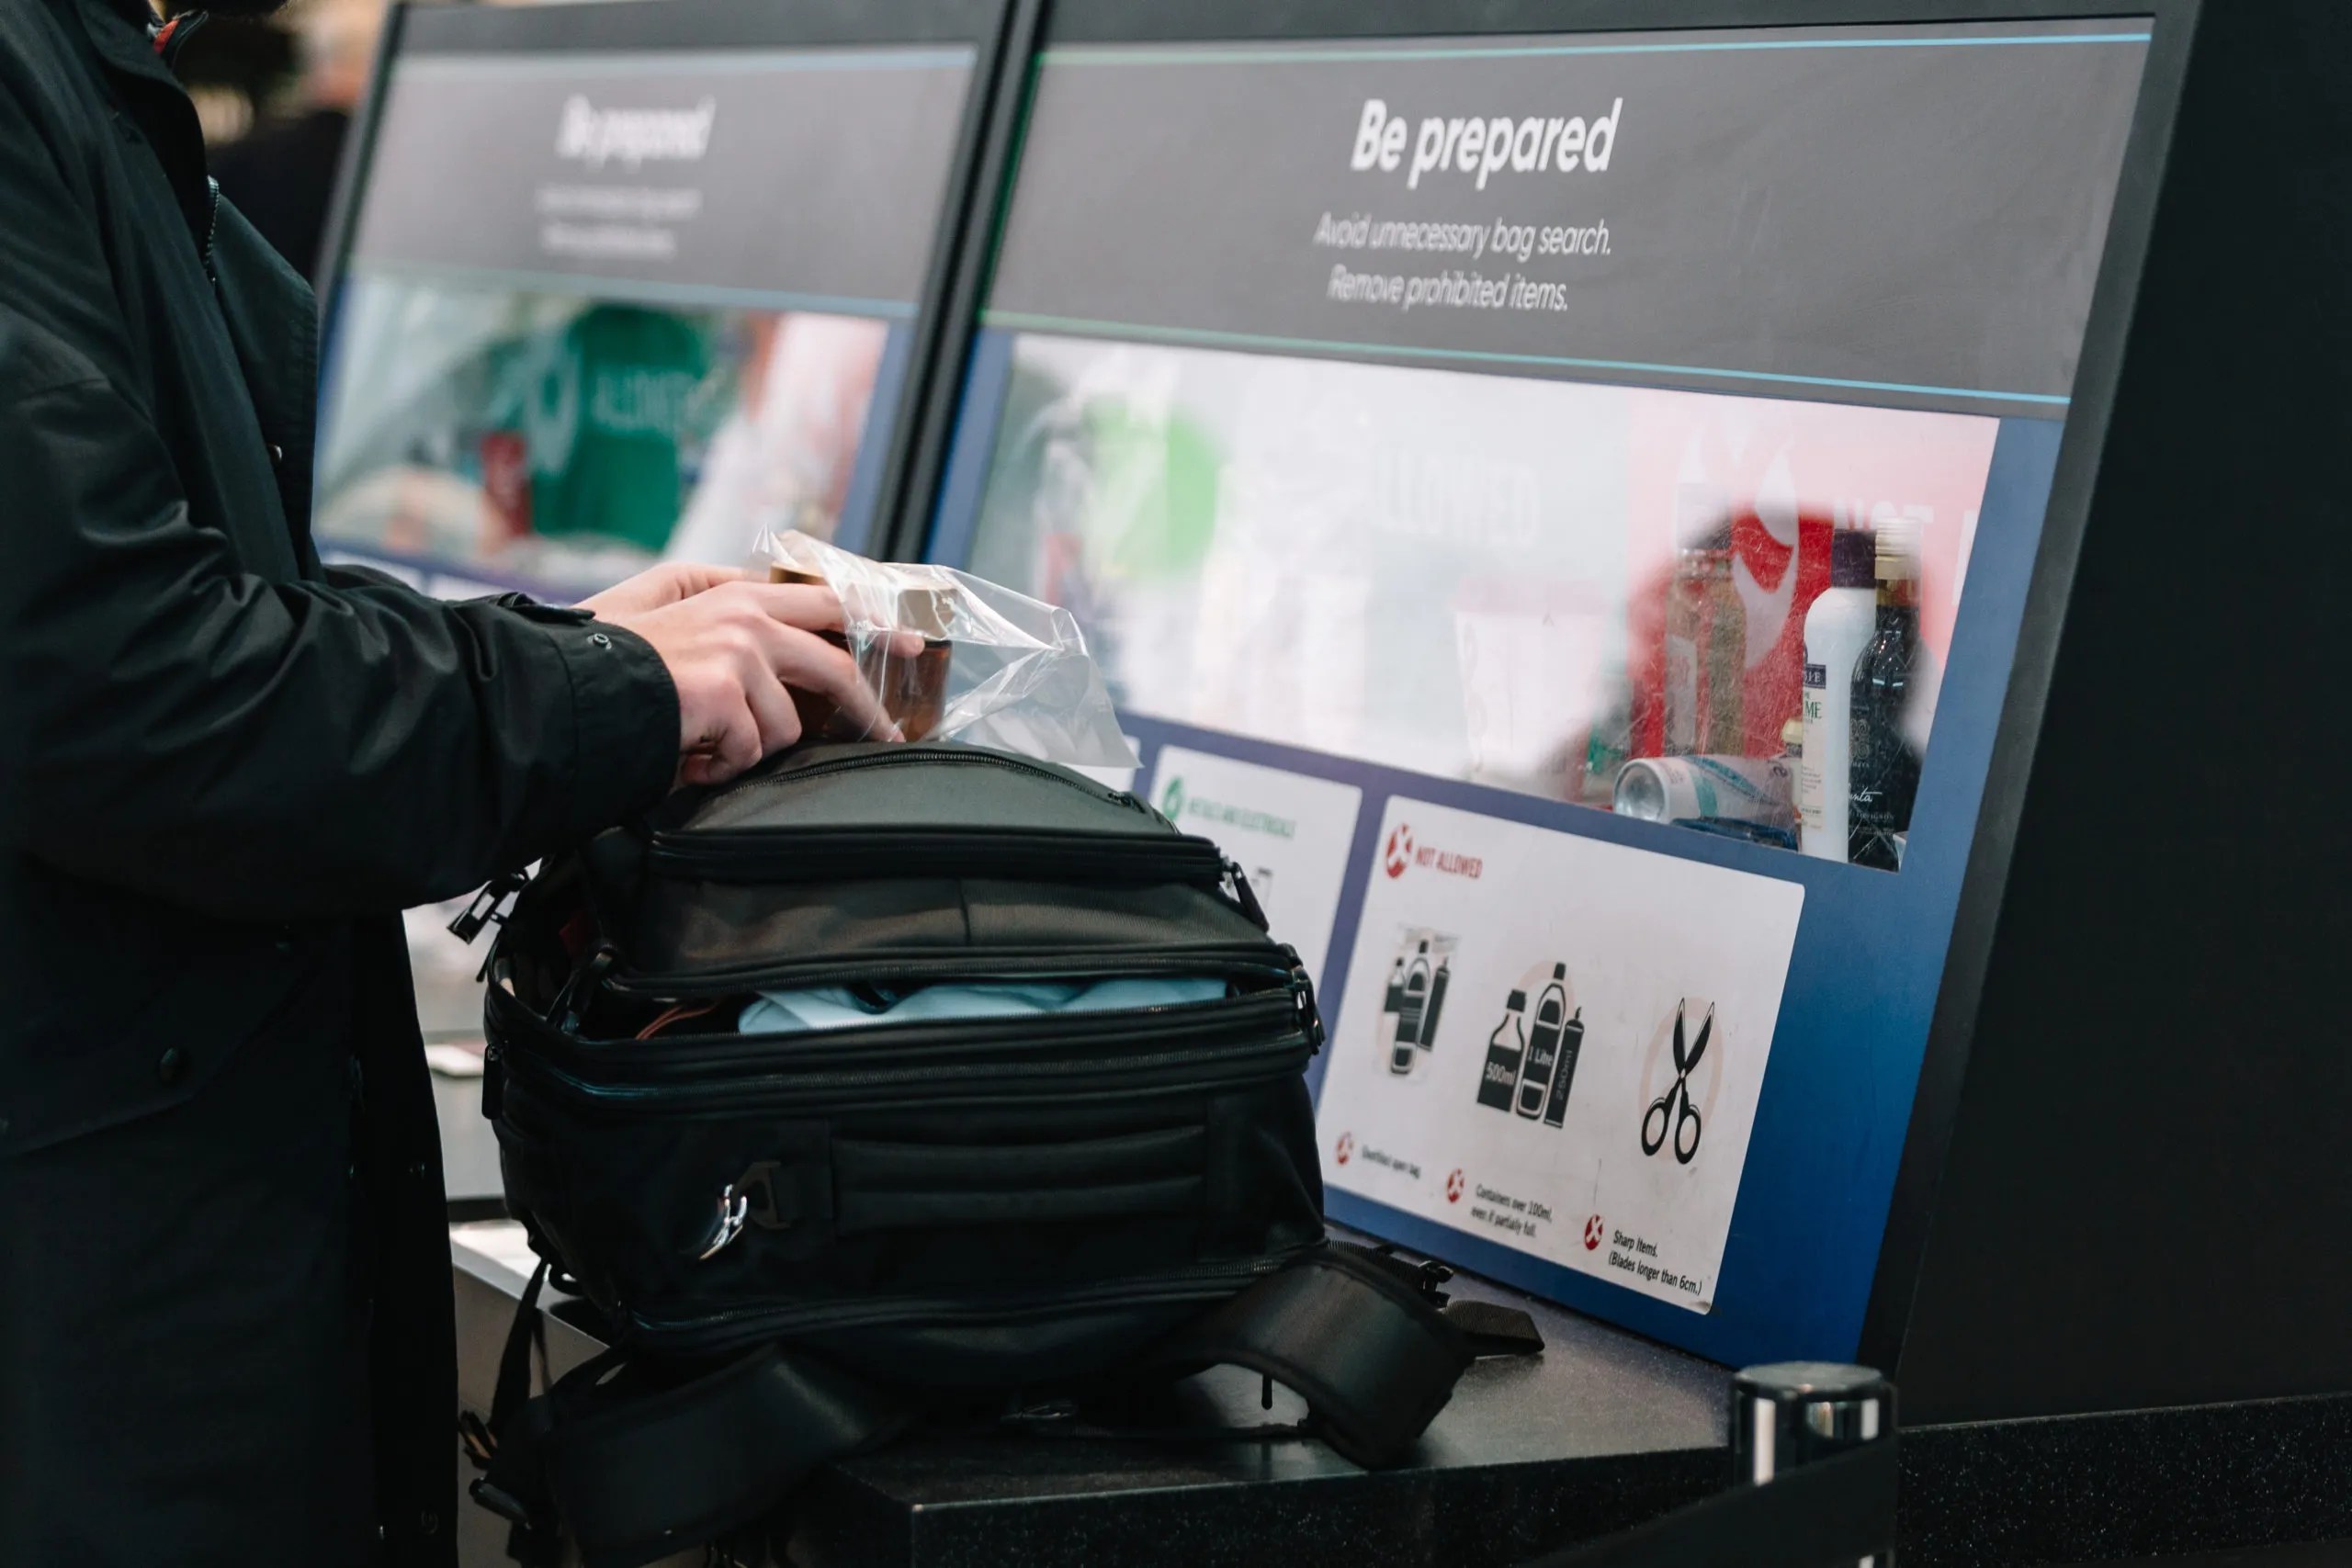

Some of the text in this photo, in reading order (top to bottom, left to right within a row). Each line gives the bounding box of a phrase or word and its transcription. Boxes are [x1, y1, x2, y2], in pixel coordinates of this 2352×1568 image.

[1350, 96, 1623, 191] Be prepared
[1316, 212, 1611, 263] Avoid unnecessary bag search.
[1327, 263, 1569, 312] Remove prohibited items.
[1416, 845, 1484, 879] NOT ALLOWED
[1485, 1061, 1517, 1086] 500ml
[1613, 1229, 1635, 1253] Sharp
[1608, 1250, 1702, 1296] (Blades longer than 6cm.)
